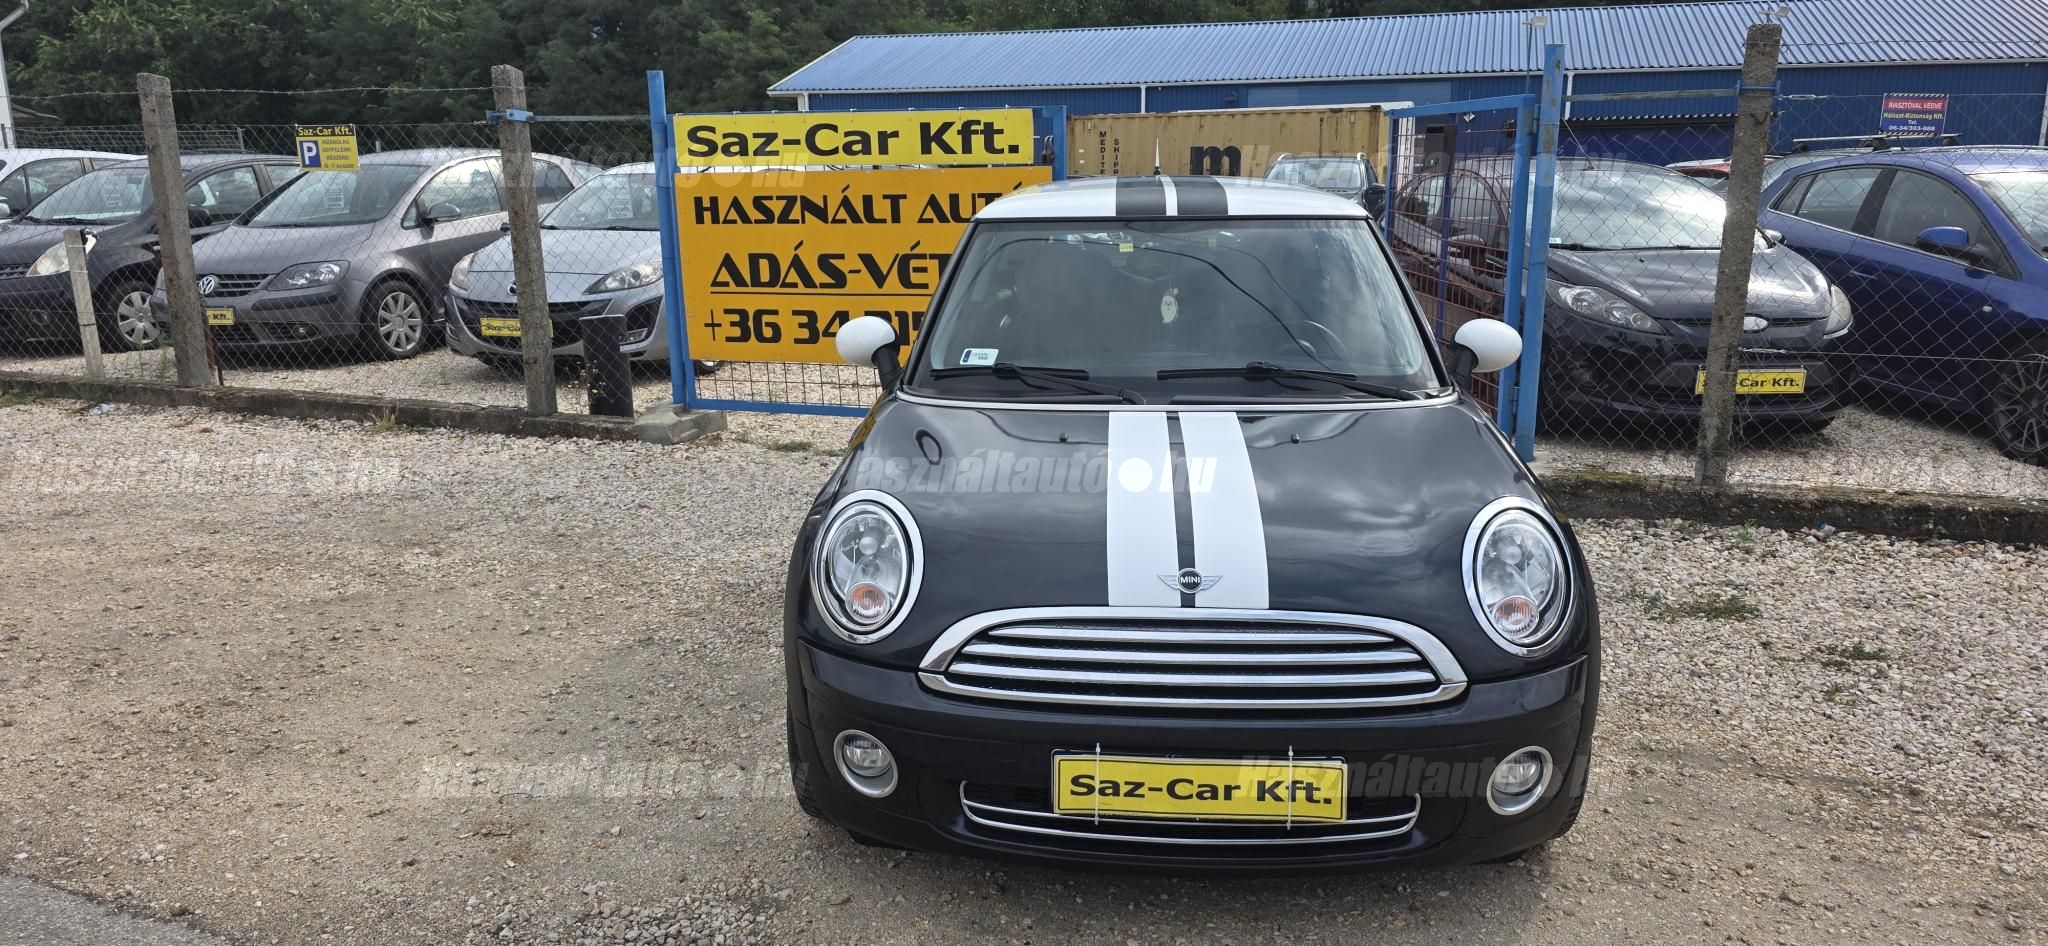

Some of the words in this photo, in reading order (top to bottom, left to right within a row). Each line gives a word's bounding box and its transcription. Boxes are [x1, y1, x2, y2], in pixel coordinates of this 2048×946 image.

[298, 127, 332, 136] Saz-Car
[334, 126, 352, 135] Kft.
[686, 123, 899, 157] Saz-Car
[919, 119, 1021, 155] Kft.
[302, 142, 317, 165] P
[694, 183, 907, 225] HASZNÁLT
[917, 181, 1022, 223] AUT
[704, 308, 782, 344] +36
[1772, 378, 1799, 387] Kft.
[1070, 774, 1241, 801] Saz-Car
[1257, 780, 1332, 804] Kft.
